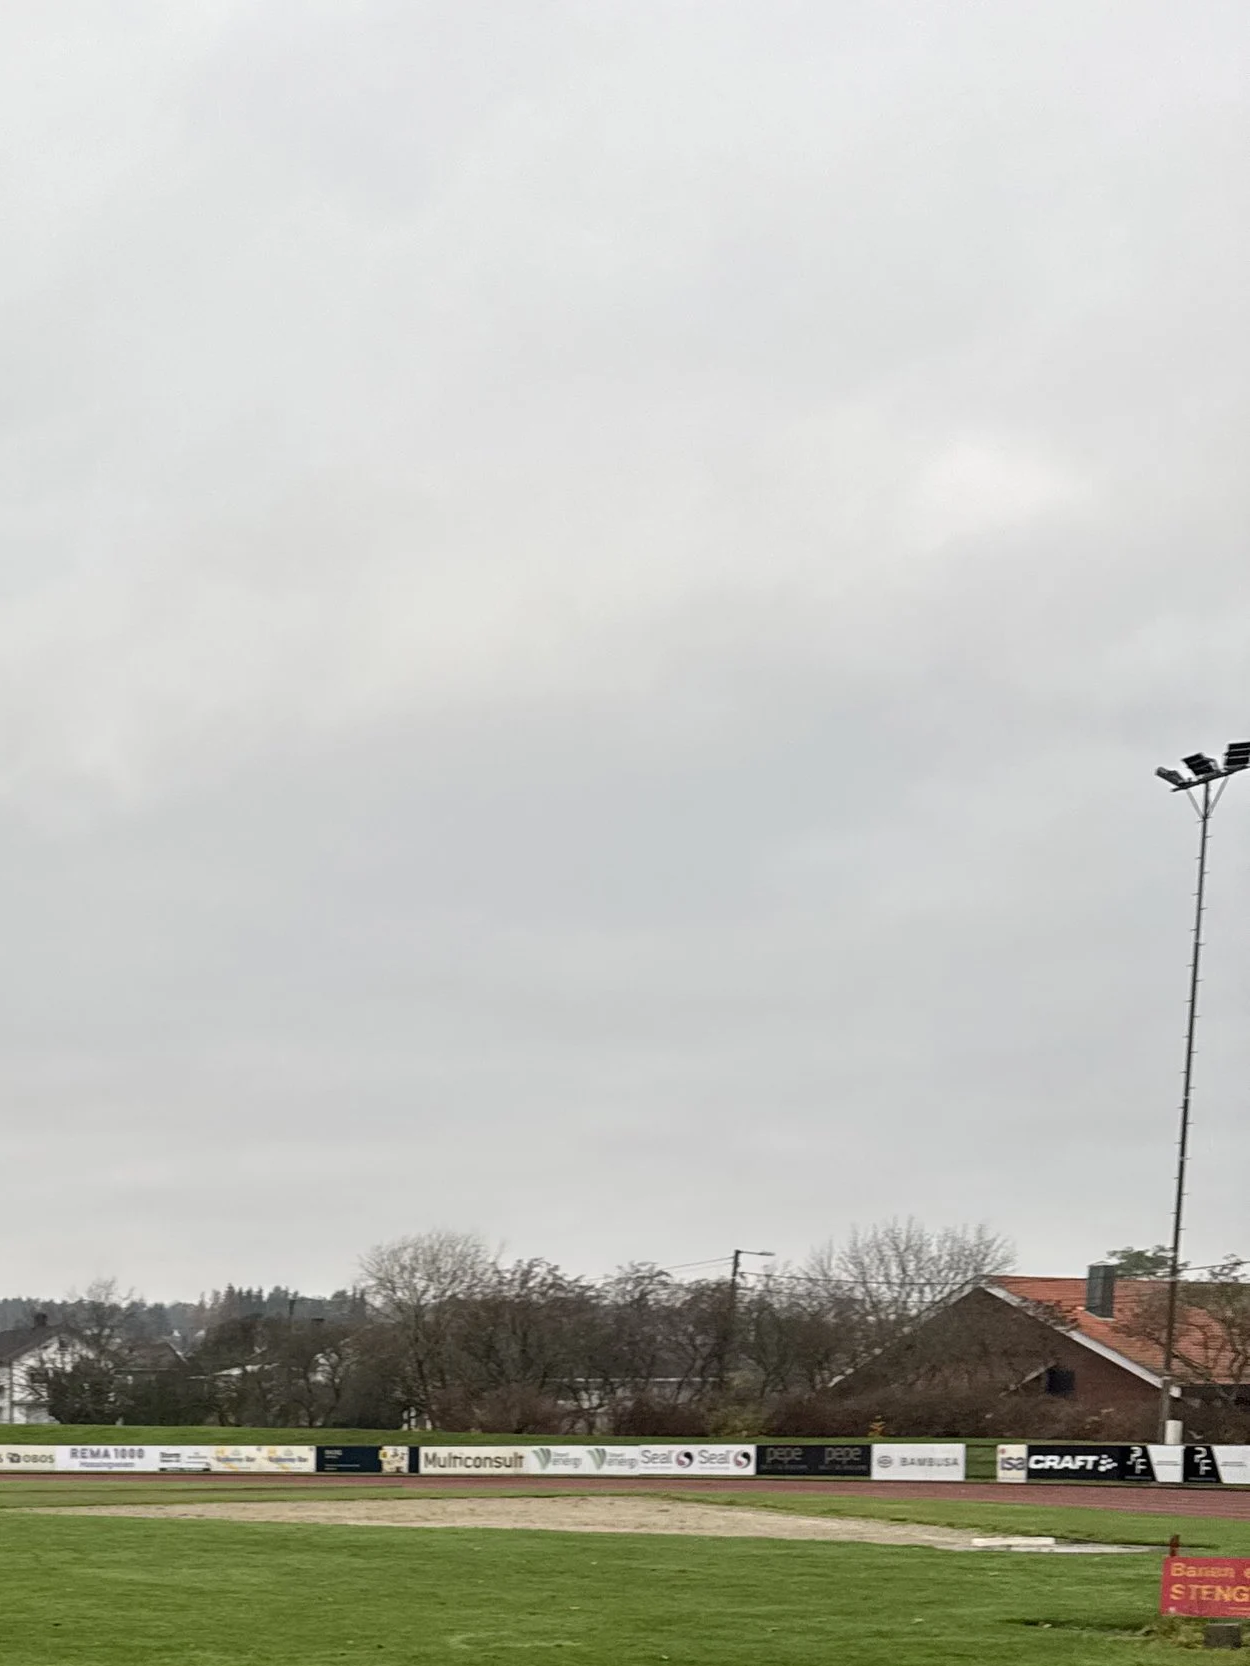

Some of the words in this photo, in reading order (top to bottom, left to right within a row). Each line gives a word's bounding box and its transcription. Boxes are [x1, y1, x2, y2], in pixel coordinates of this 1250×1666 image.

[69, 1448, 111, 1459] REMA
[113, 1448, 145, 1459] 1000
[424, 1452, 524, 1468] Multiconsult
[641, 1449, 674, 1464] Seal
[698, 1449, 733, 1464] Seal
[900, 1457, 959, 1467] BAMBUSA
[1029, 1455, 1099, 1470] CRAFT
